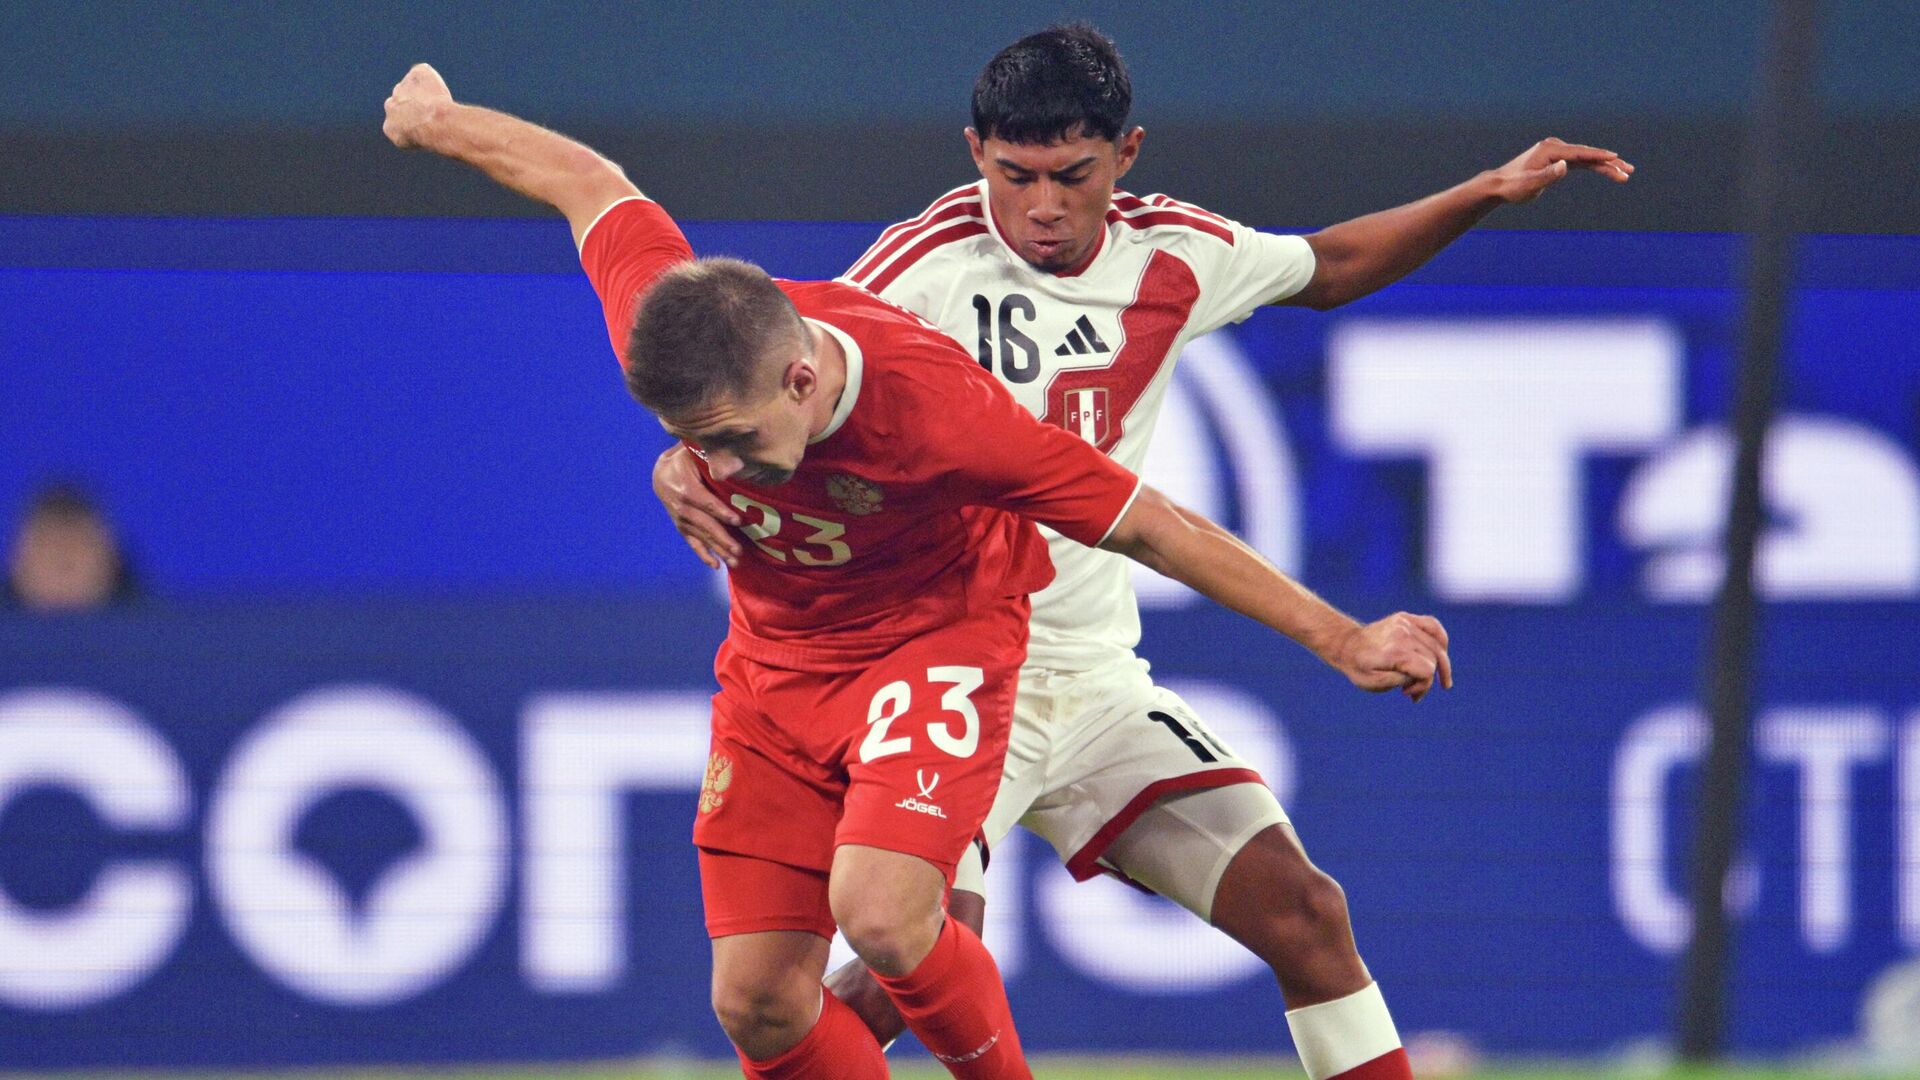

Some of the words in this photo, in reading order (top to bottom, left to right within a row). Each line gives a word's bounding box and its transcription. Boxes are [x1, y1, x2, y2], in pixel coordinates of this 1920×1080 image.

[972, 293, 1041, 384] 16
[1071, 409, 1103, 423] FPF
[730, 493, 852, 567] 23
[858, 665, 985, 764] 23
[894, 797, 948, 819] JÖGEL
[1611, 706, 1920, 954] СТ
